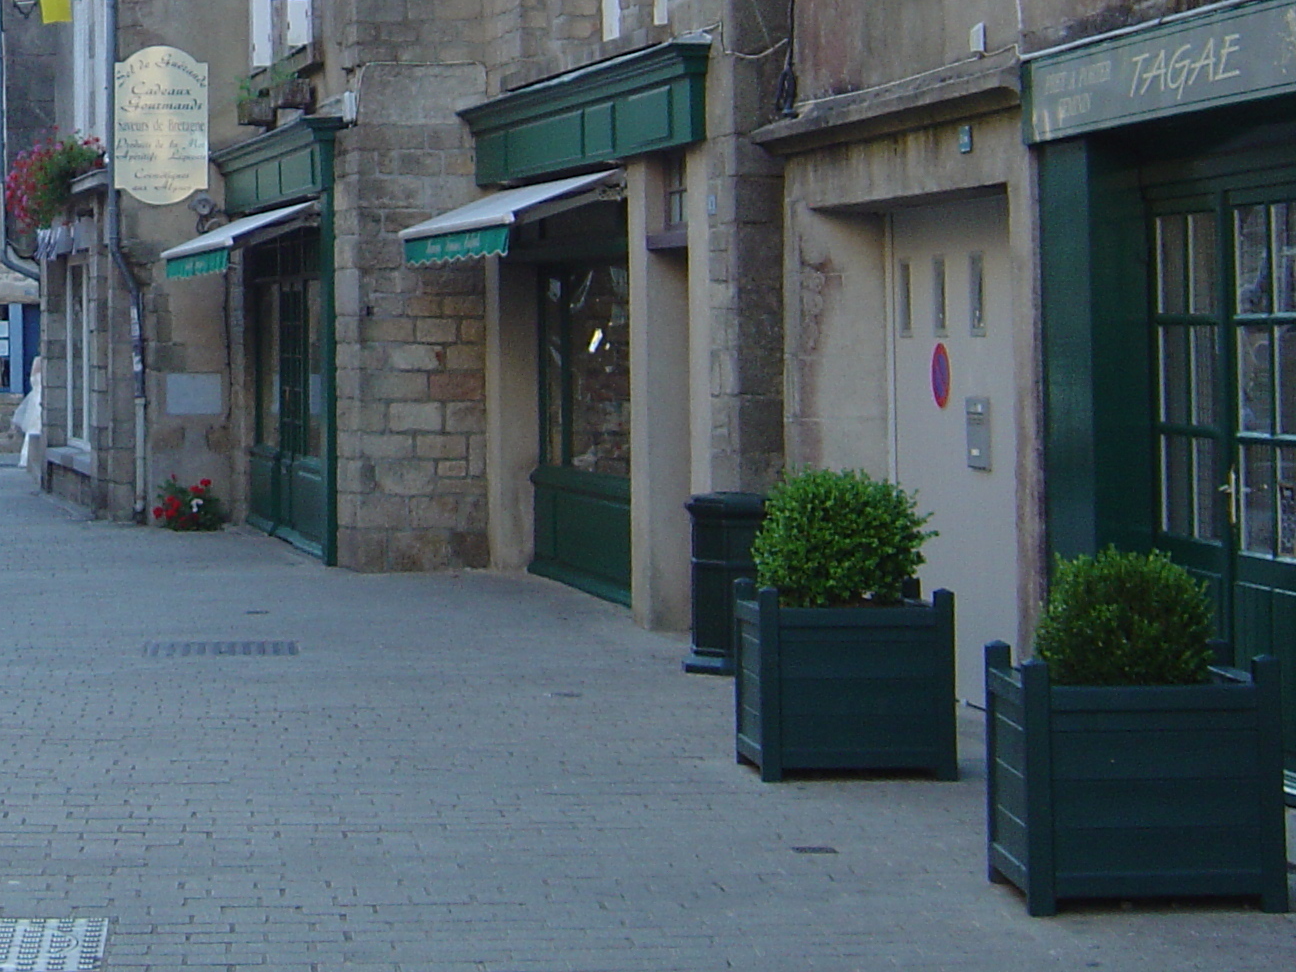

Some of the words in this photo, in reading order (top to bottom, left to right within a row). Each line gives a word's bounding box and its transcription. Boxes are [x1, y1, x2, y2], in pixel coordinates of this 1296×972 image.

[116, 63, 135, 88] Sel
[138, 59, 150, 70] de
[1129, 33, 1241, 100] TAGAE
[131, 81, 192, 96] Cadeaux
[120, 96, 203, 112] Gourmands
[118, 120, 149, 132] Saveurs
[153, 119, 164, 132] de
[168, 119, 205, 135] Bretagne
